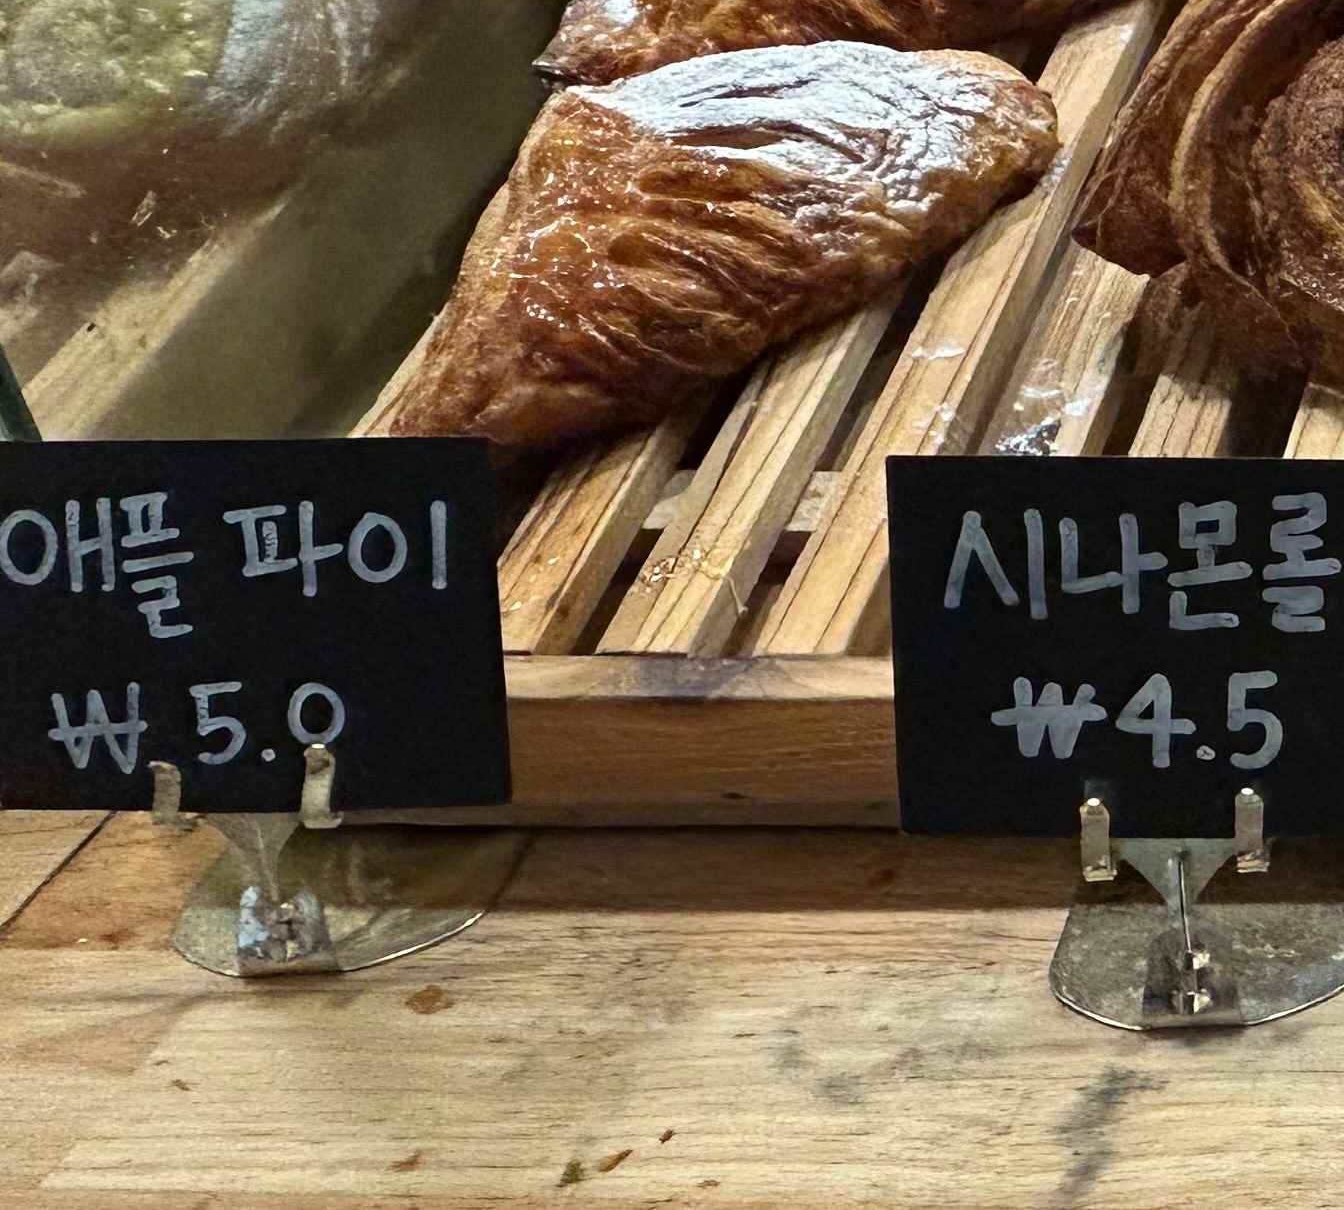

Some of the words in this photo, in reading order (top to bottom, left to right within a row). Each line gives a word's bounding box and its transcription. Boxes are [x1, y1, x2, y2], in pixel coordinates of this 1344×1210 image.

[0, 492, 194, 639] 애플
[222, 499, 448, 597] 파이
[944, 492, 1342, 632] 시나몬롤
[991, 670, 1284, 769] ₩4.5
